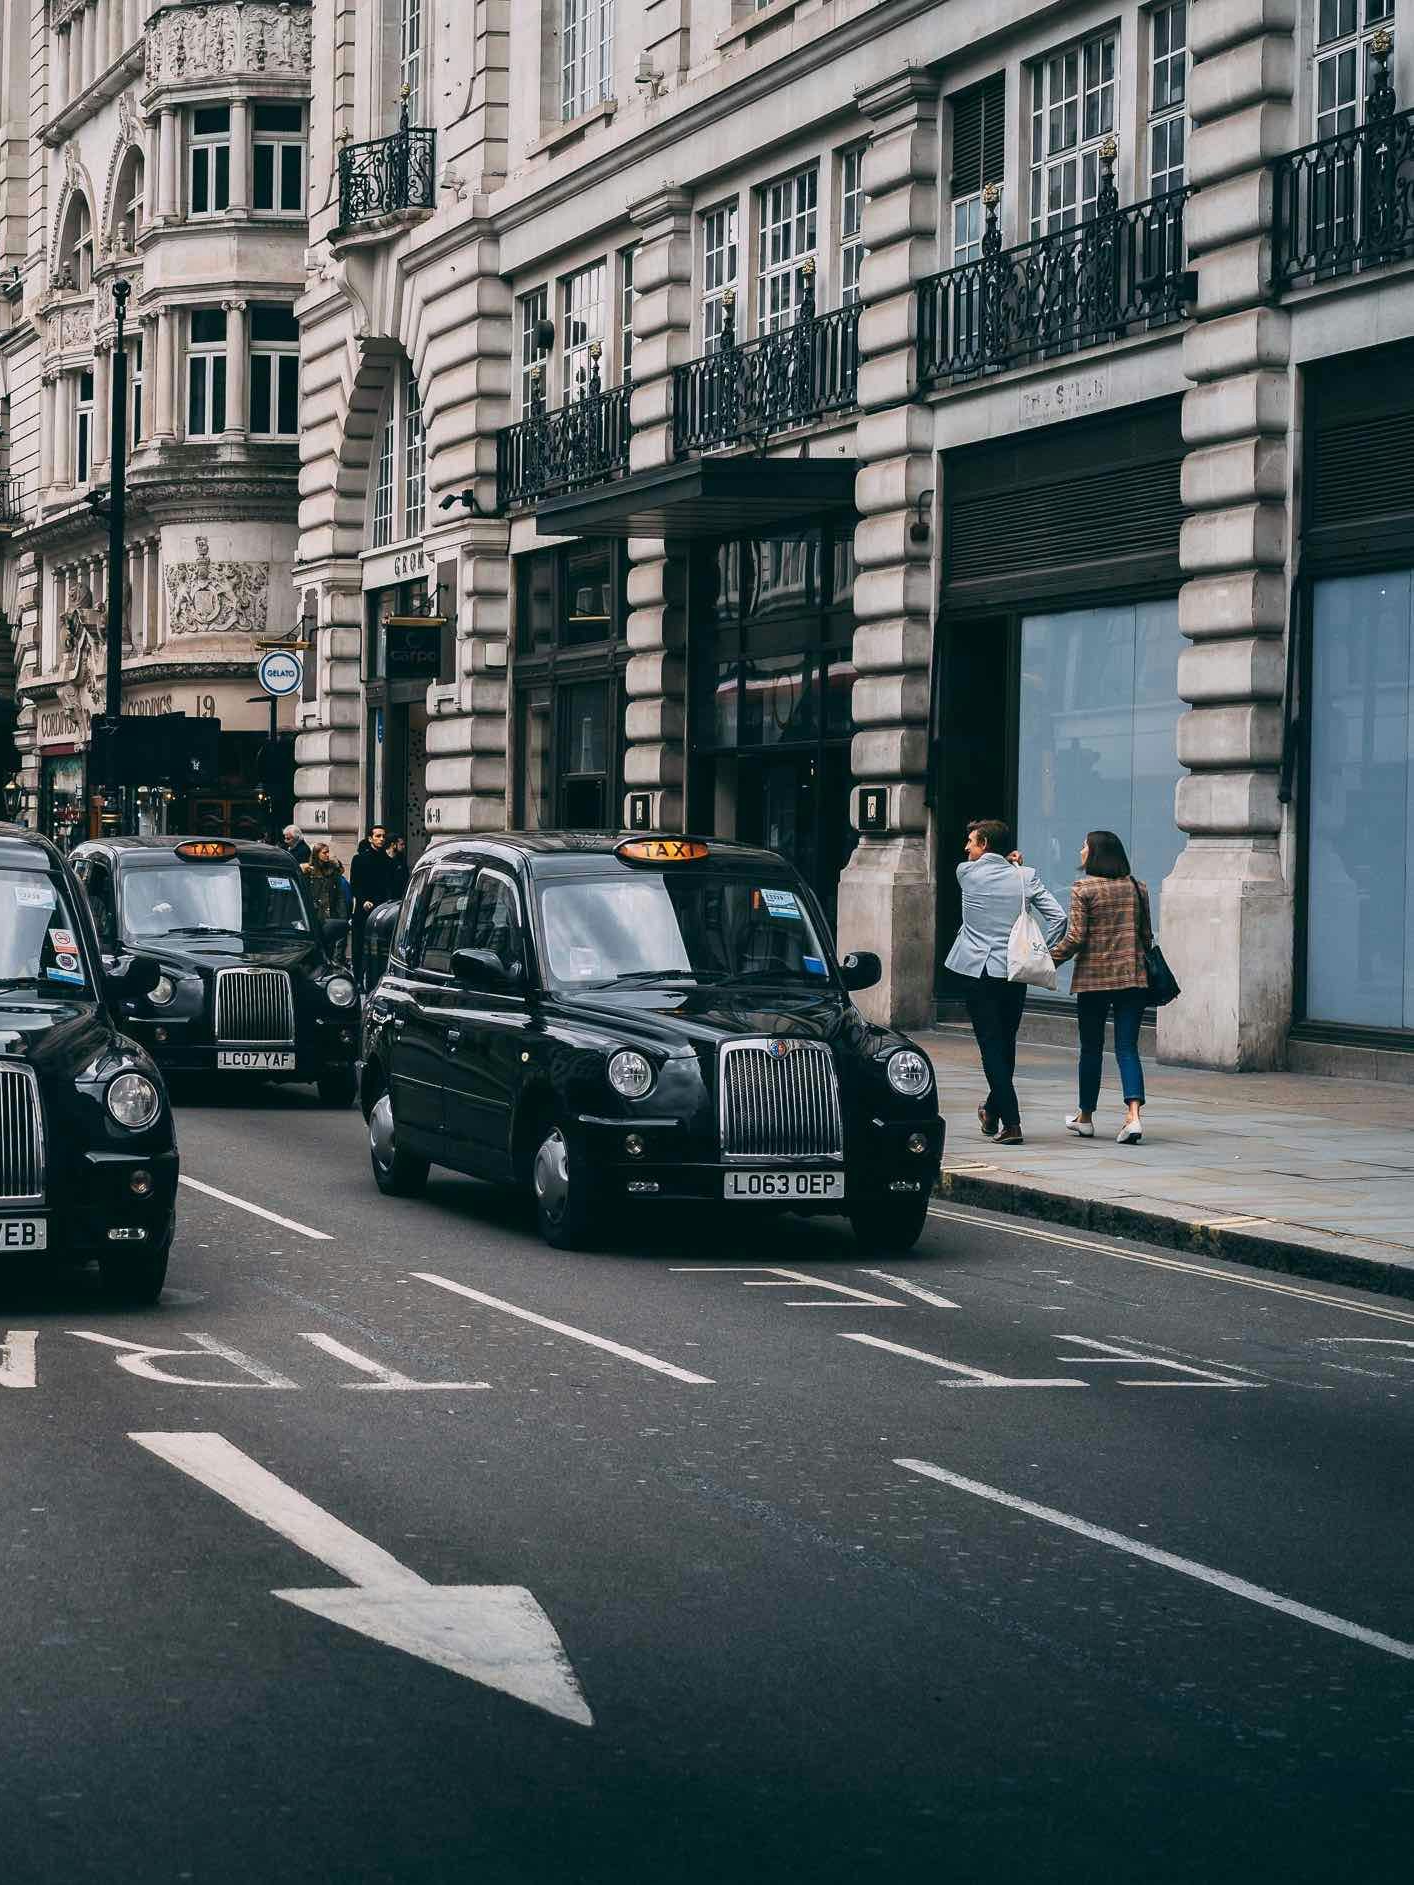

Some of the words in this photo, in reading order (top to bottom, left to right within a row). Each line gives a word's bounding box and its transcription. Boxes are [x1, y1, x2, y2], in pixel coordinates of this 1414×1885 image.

[267, 669, 295, 678] GELATO
[196, 694, 215, 718] 19
[642, 842, 694, 858] TAXI
[223, 1053, 259, 1066] LC07
[264, 1053, 290, 1067] YAF
[733, 1174, 790, 1195] LO63
[795, 1174, 836, 1195] OEP
